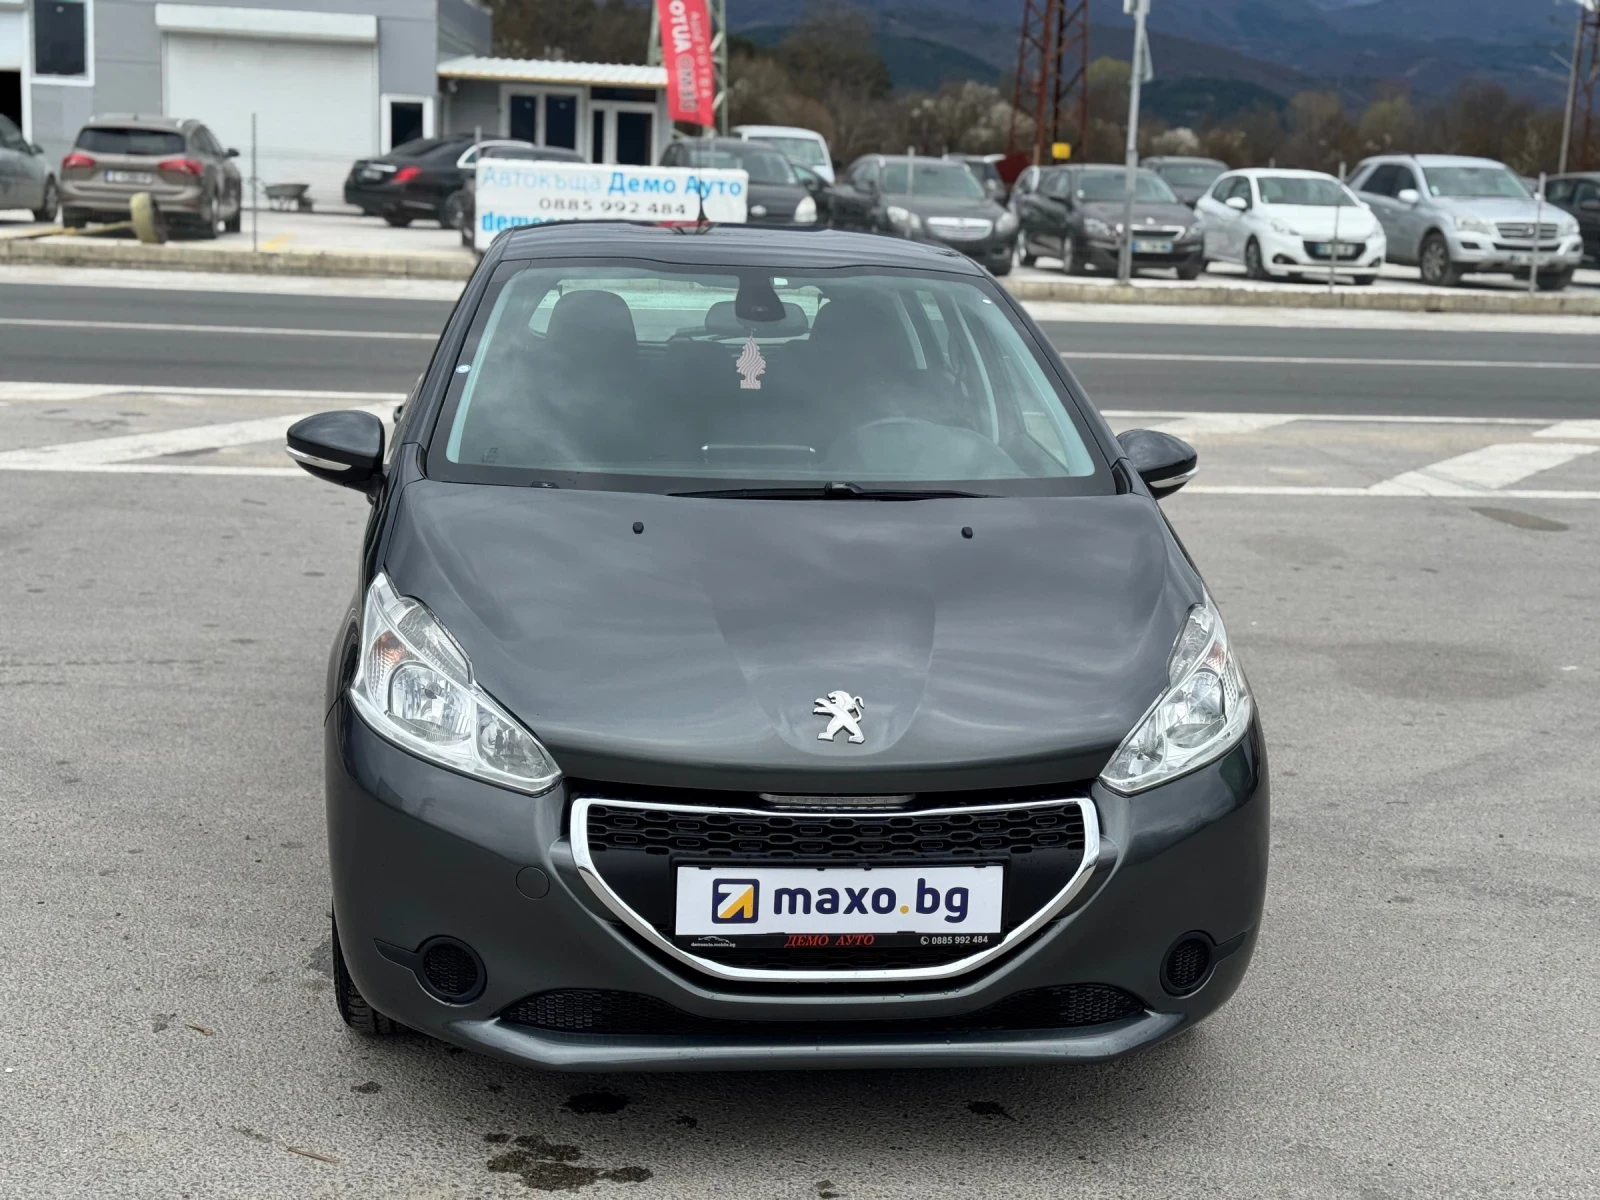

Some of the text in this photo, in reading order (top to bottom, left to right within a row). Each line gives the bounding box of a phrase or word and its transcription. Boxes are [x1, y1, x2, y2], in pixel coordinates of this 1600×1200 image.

[483, 166, 743, 199] Автокъща Демо Ауто
[540, 197, 686, 217] 0885 992 484
[773, 877, 970, 924] maxo.bg
[784, 934, 875, 949] ДЕМО АУТО
[931, 935, 989, 945] 0885 992 484
